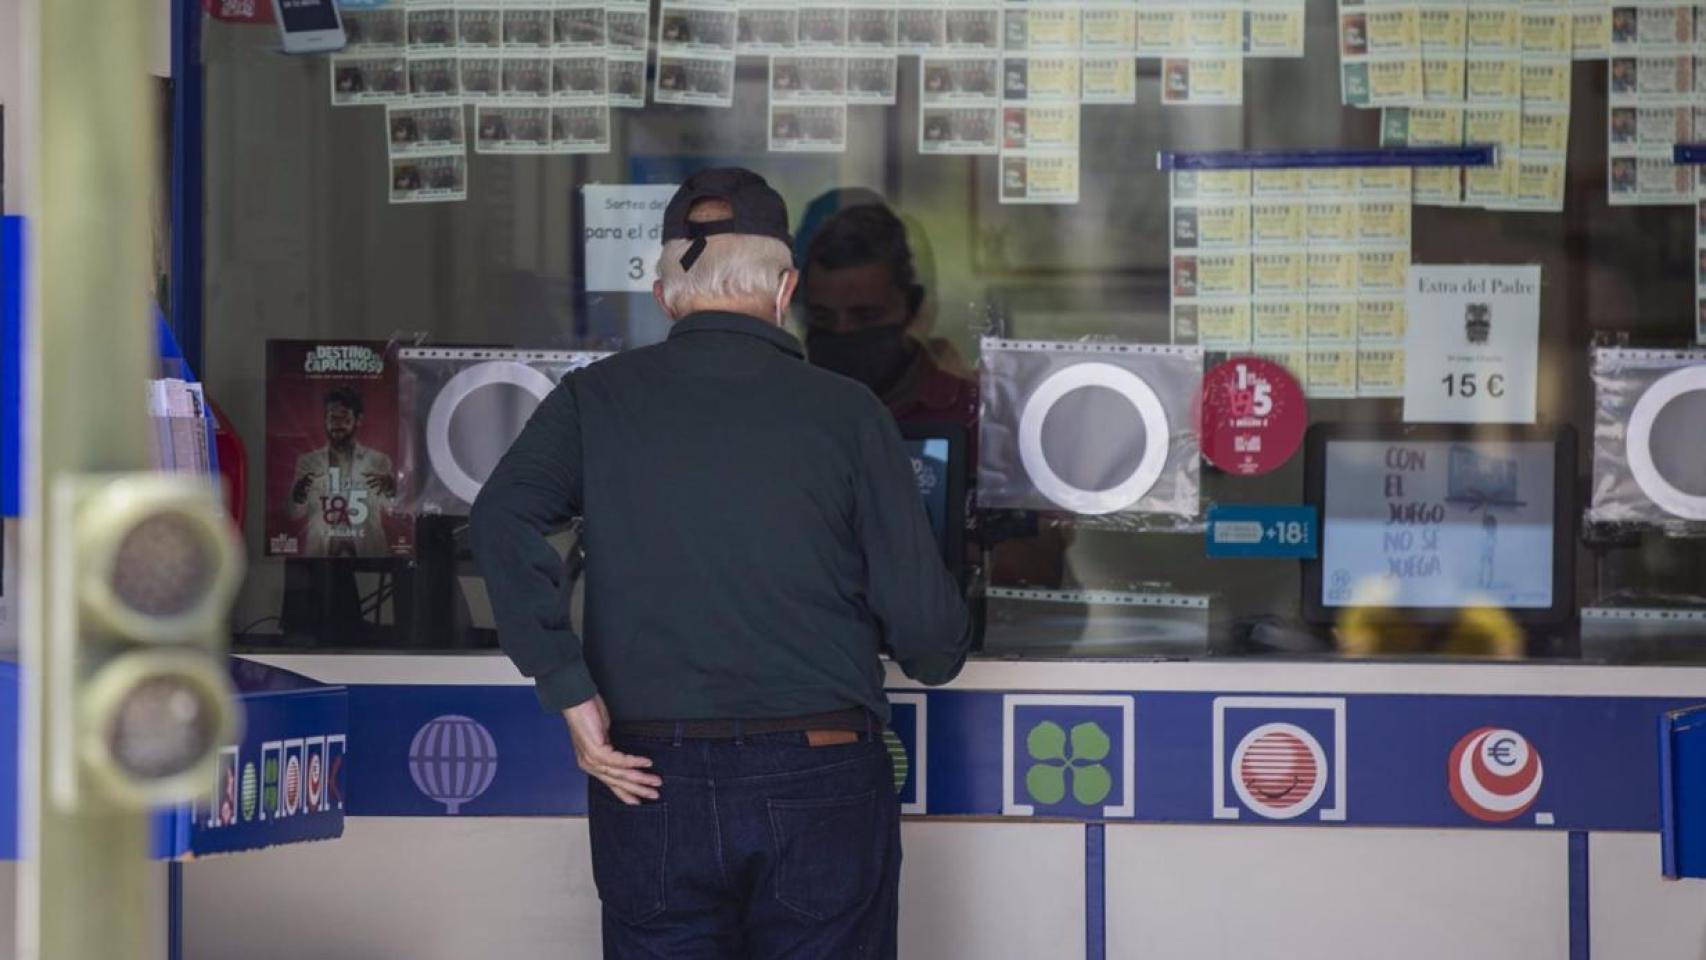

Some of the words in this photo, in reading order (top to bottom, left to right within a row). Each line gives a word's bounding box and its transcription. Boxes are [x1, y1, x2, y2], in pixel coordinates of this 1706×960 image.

[604, 198, 645, 210] Sorteo
[585, 227, 622, 241] para
[628, 224, 642, 240] el
[628, 256, 645, 280] 3
[1418, 277, 1458, 294] Extra
[1462, 278, 1485, 294] del
[1491, 279, 1535, 295] Padre
[316, 345, 371, 360] DESTINO
[1235, 364, 1247, 390] 1
[1441, 373, 1477, 398] 15
[1253, 384, 1272, 416] 5
[1385, 446, 1426, 471] CON
[1384, 474, 1403, 498] EL
[348, 490, 368, 525] 5
[1386, 502, 1445, 525] JUEGO
[1383, 530, 1413, 552] NO
[1422, 529, 1440, 551] SE
[1386, 557, 1441, 577] JUEGA
